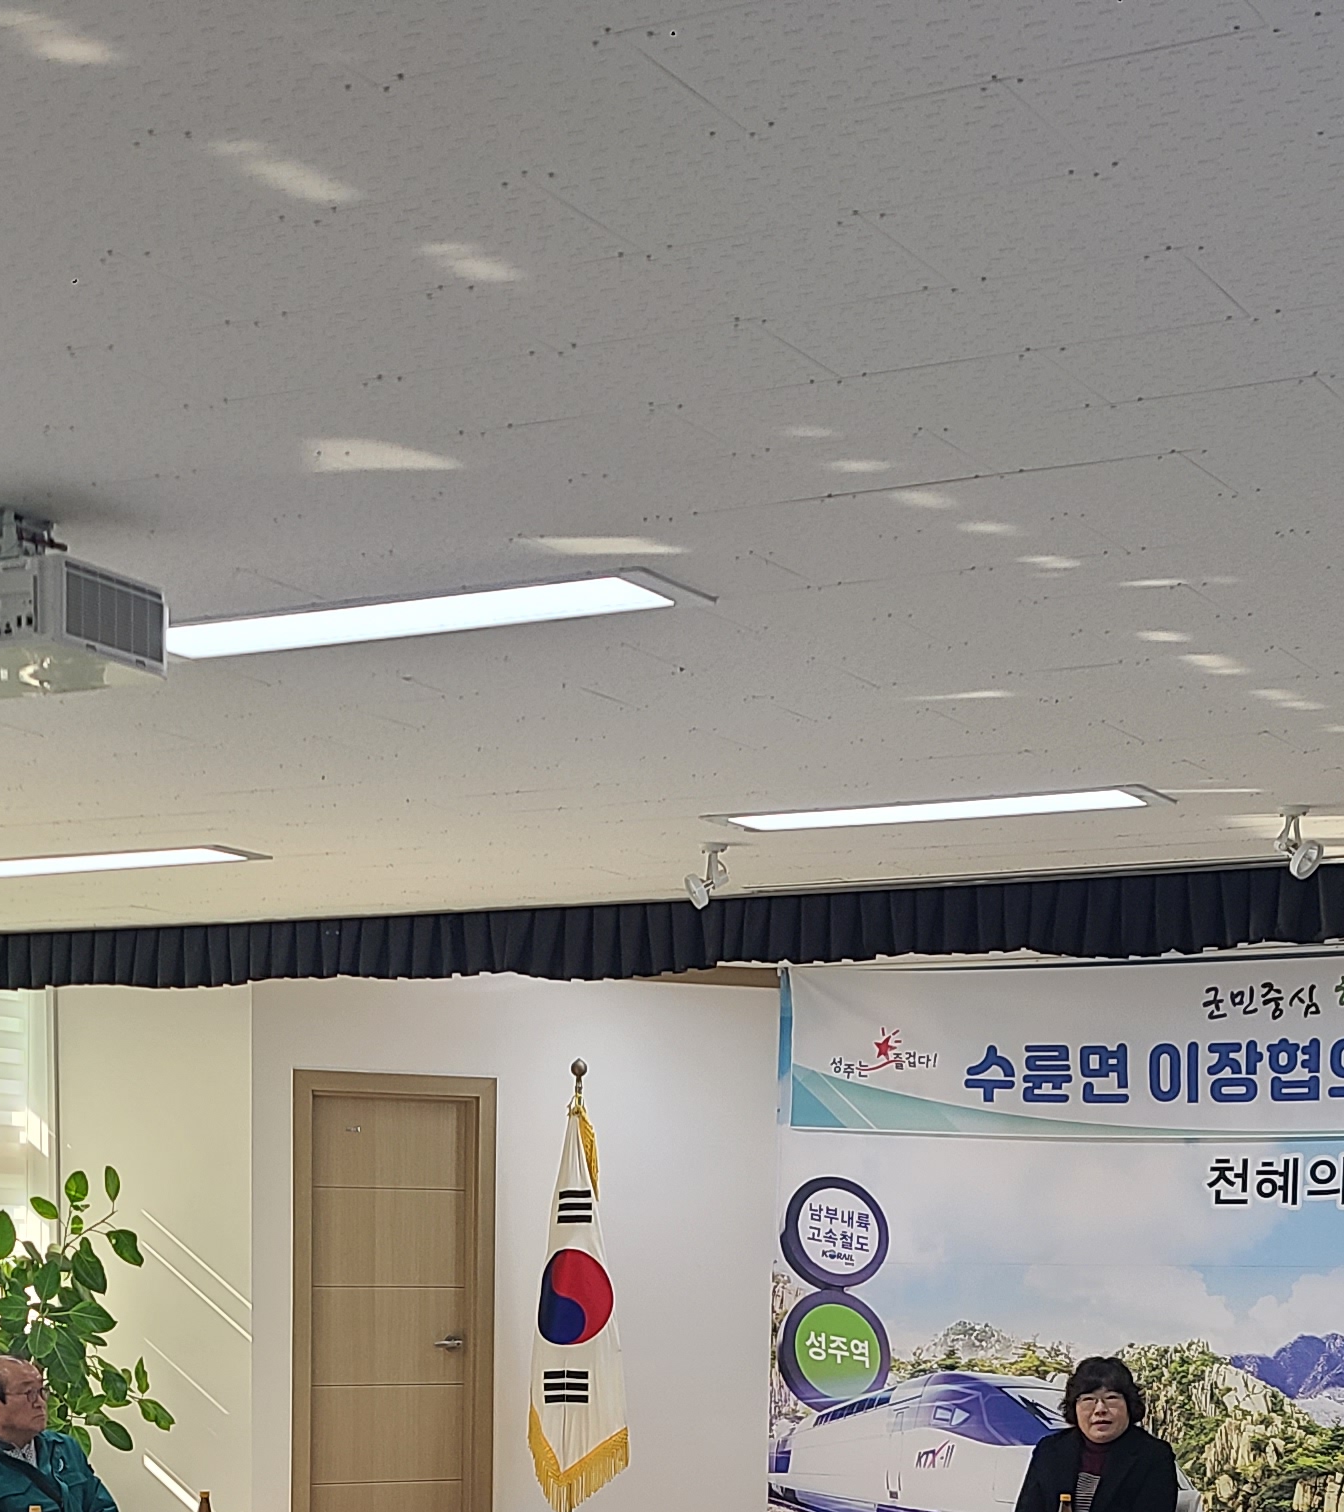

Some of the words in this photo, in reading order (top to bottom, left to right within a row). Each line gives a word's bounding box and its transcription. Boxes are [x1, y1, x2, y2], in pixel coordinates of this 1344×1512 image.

[1202, 982, 1322, 1021] 군민중심
[829, 1056, 870, 1078] 성주는
[892, 1051, 938, 1070] 즐겁다!
[962, 1043, 1131, 1105] 수륜면
[807, 1202, 872, 1232] 남부내륙
[806, 1225, 870, 1253] 고속철도
[821, 1249, 855, 1263] KORAIL
[805, 1329, 871, 1369] 성주역
